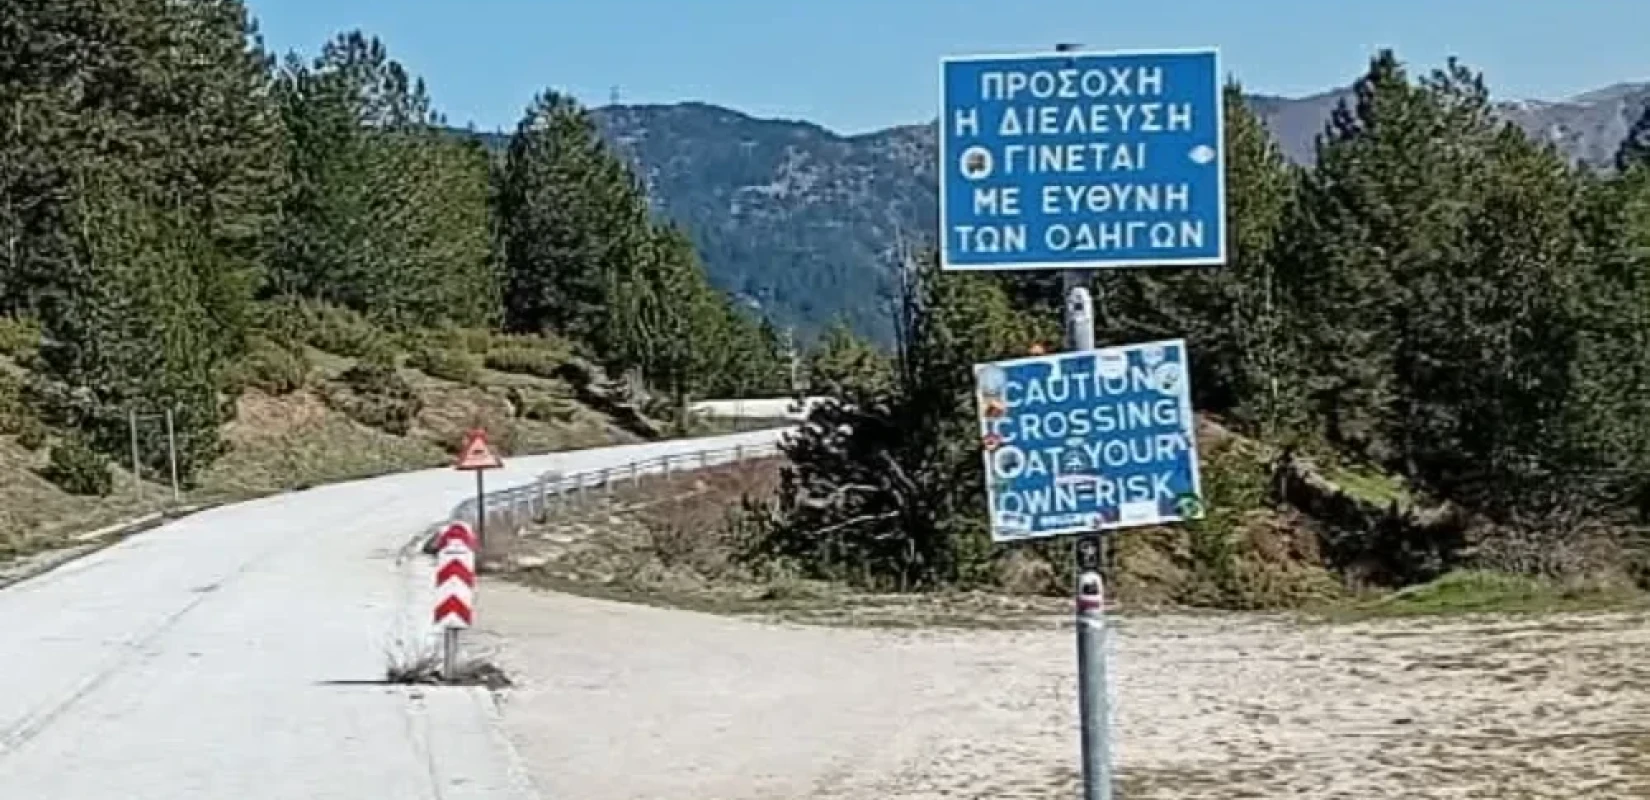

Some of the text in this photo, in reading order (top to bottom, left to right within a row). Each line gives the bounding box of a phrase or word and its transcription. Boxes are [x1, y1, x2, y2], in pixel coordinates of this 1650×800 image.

[981, 66, 1163, 100] ΠΡΟΣΟΧΗ
[955, 102, 1192, 136] Η ΔΙΕΛΕΥΣΗ
[1004, 143, 1146, 173] ΓΙΝΕΤΑΙ
[974, 183, 1189, 215] ΜΕ ΕΥΘΥΝΗ
[954, 221, 1204, 252] ΤΩΝ ΟΔΗΓΩΝ
[1005, 366, 1156, 407] CAUTION
[992, 399, 1178, 443] CROSSING
[1026, 434, 1176, 478] AT YOUR
[1000, 472, 1175, 514] OWN RISK
